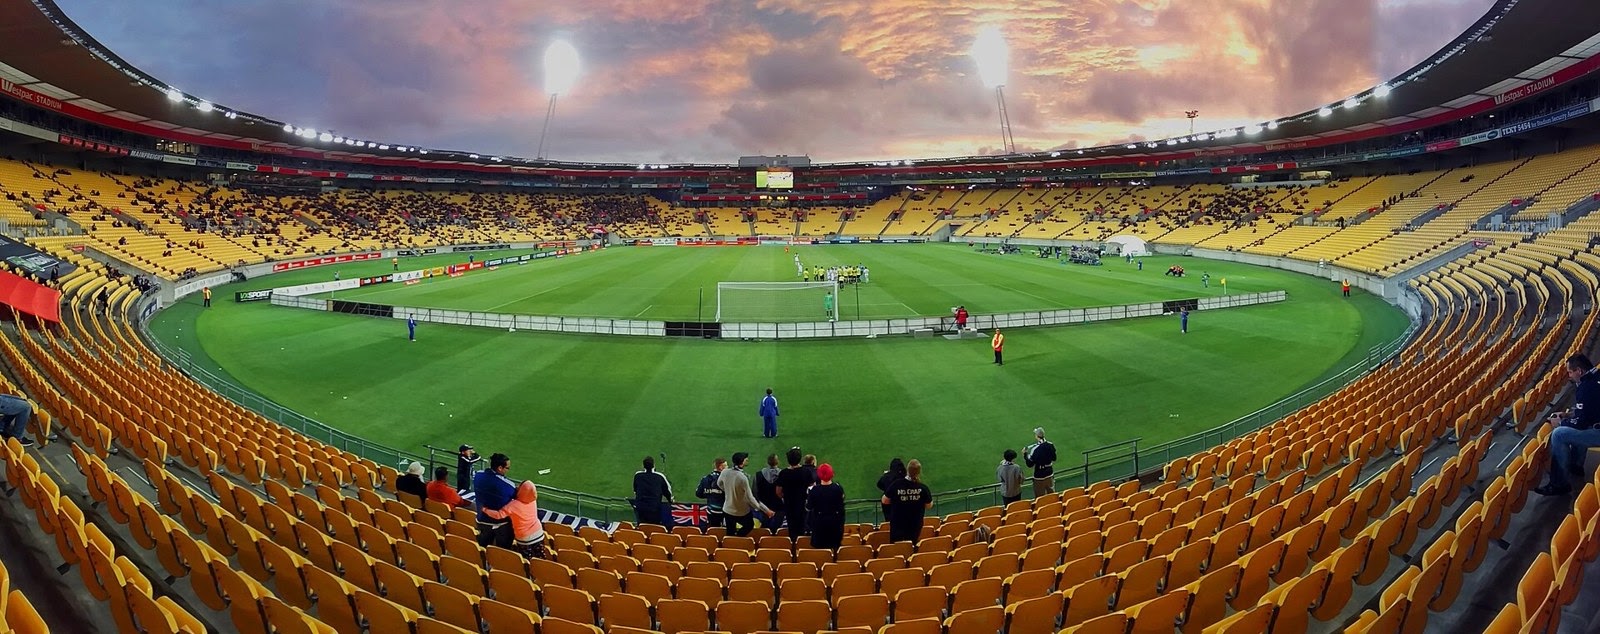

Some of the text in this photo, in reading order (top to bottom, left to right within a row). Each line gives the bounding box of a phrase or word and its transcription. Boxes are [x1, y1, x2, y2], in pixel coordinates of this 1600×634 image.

[1, 79, 62, 110] Westpac STADIUM
[1494, 77, 1555, 105] Westpac STADIUM
